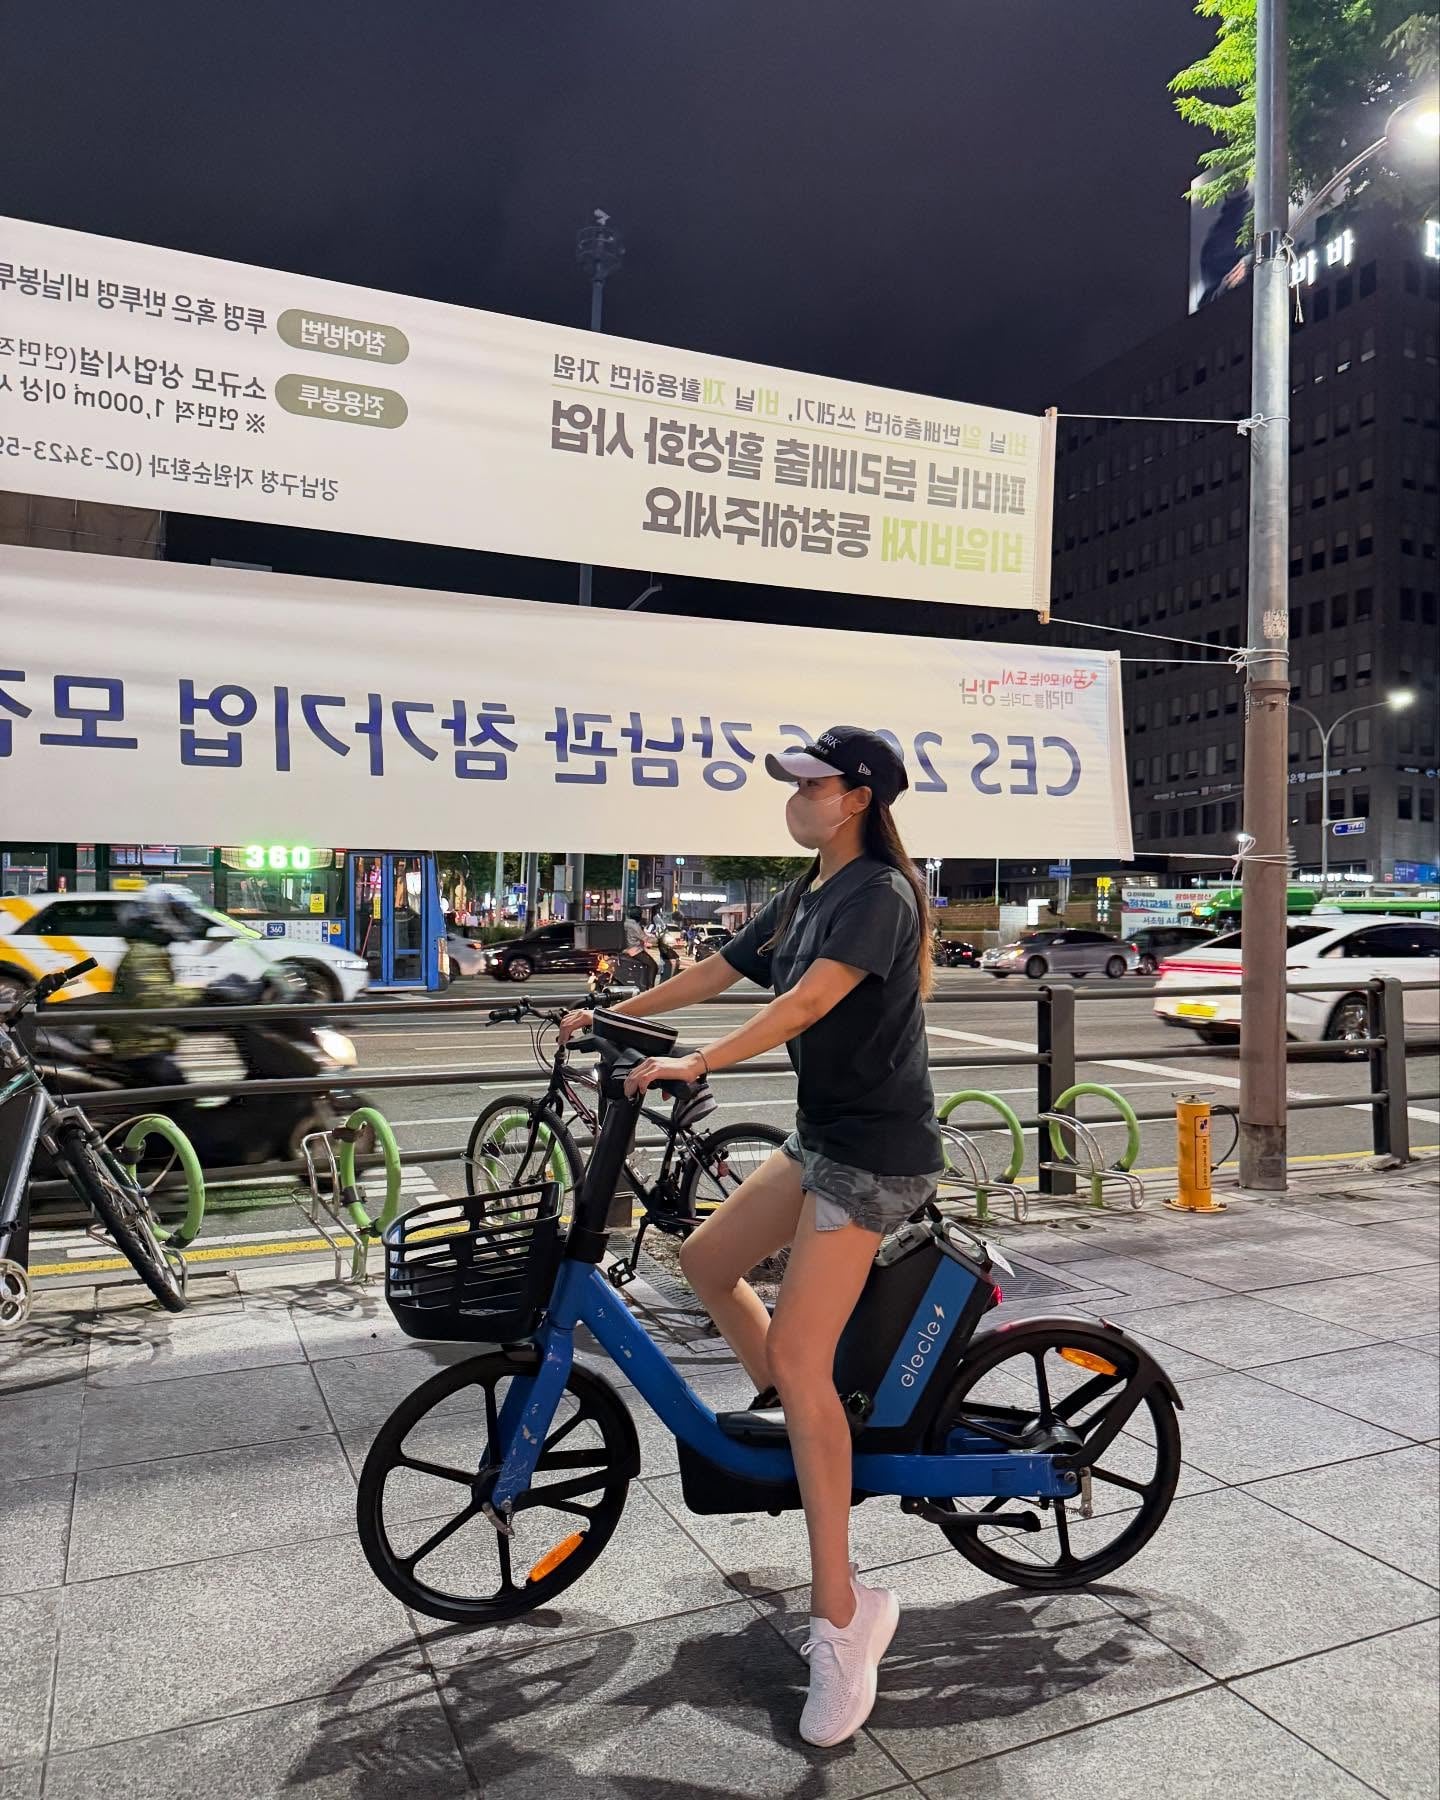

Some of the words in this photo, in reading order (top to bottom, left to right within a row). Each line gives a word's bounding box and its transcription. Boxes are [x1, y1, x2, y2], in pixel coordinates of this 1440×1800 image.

[819, 733, 841, 749] ORK
[246, 846, 311, 869] 360
[901, 1321, 941, 1387] elecle
